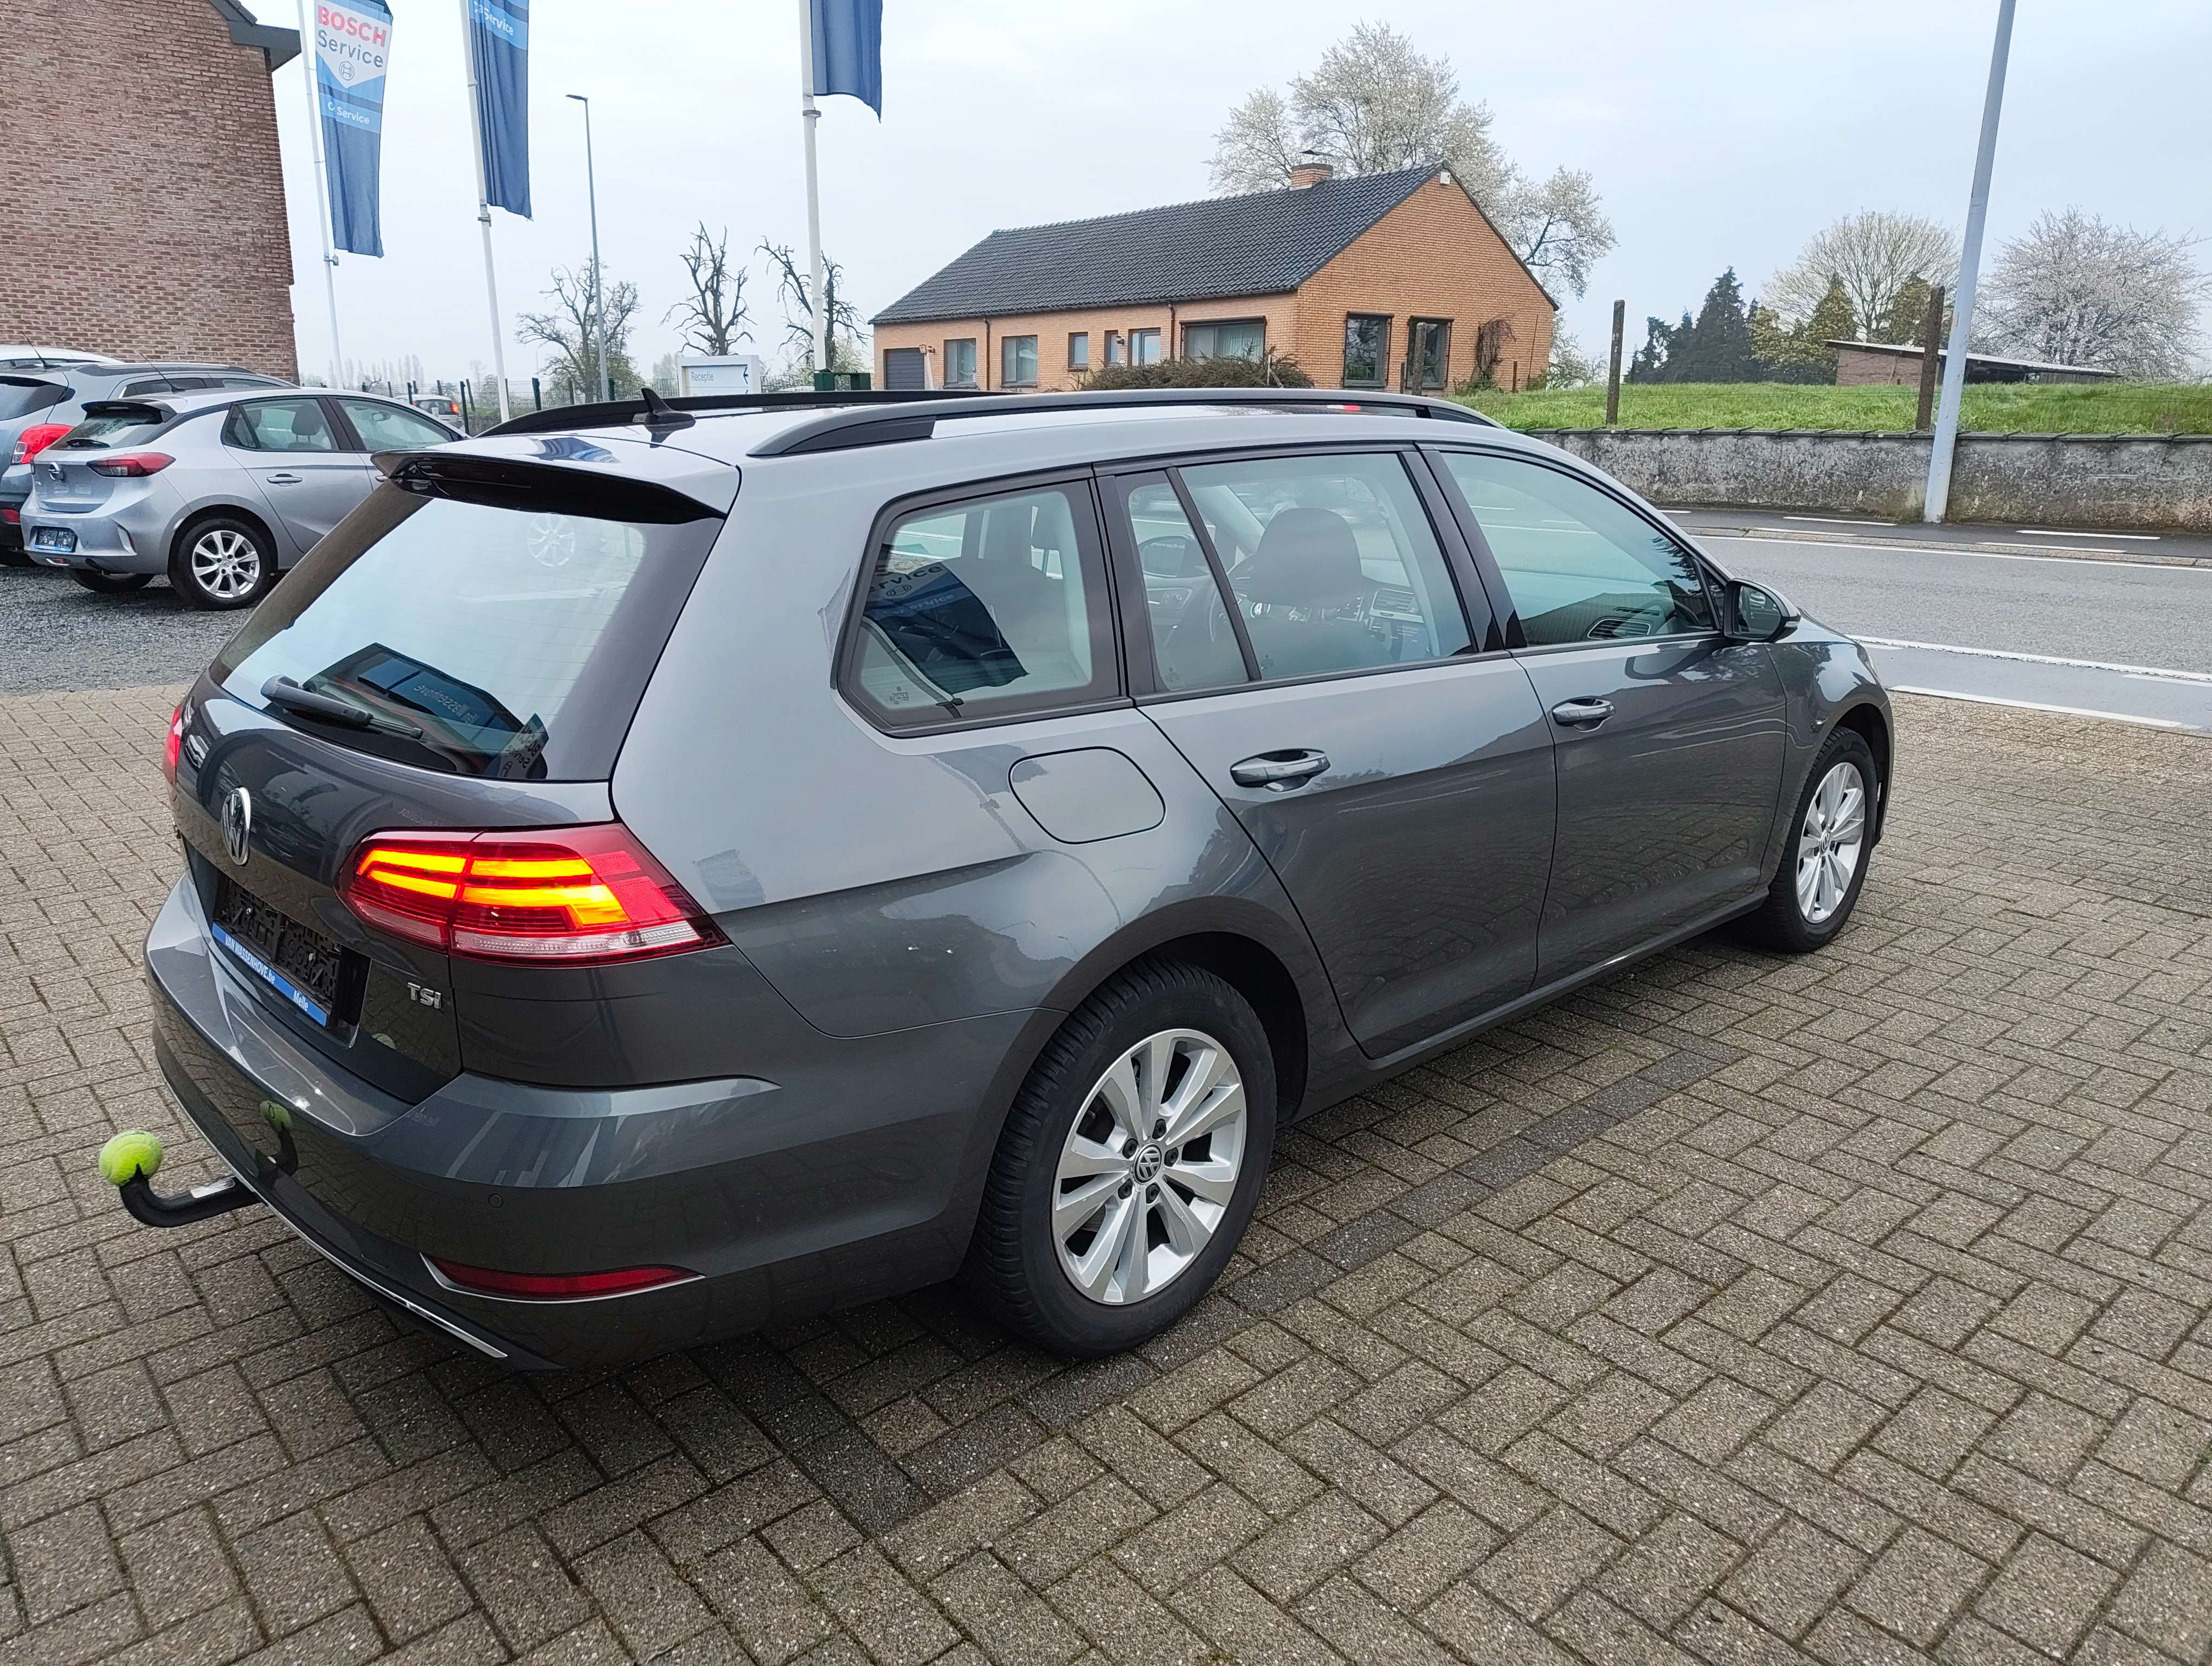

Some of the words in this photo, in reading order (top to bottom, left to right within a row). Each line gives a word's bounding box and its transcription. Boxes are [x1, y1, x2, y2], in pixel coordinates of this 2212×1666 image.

[318, 5, 387, 48] BOSCH
[318, 29, 383, 68] Service
[337, 106, 370, 124] Service
[226, 933, 236, 951] VAN
[293, 989, 308, 1011] Melle
[407, 982, 441, 1009] TSI
